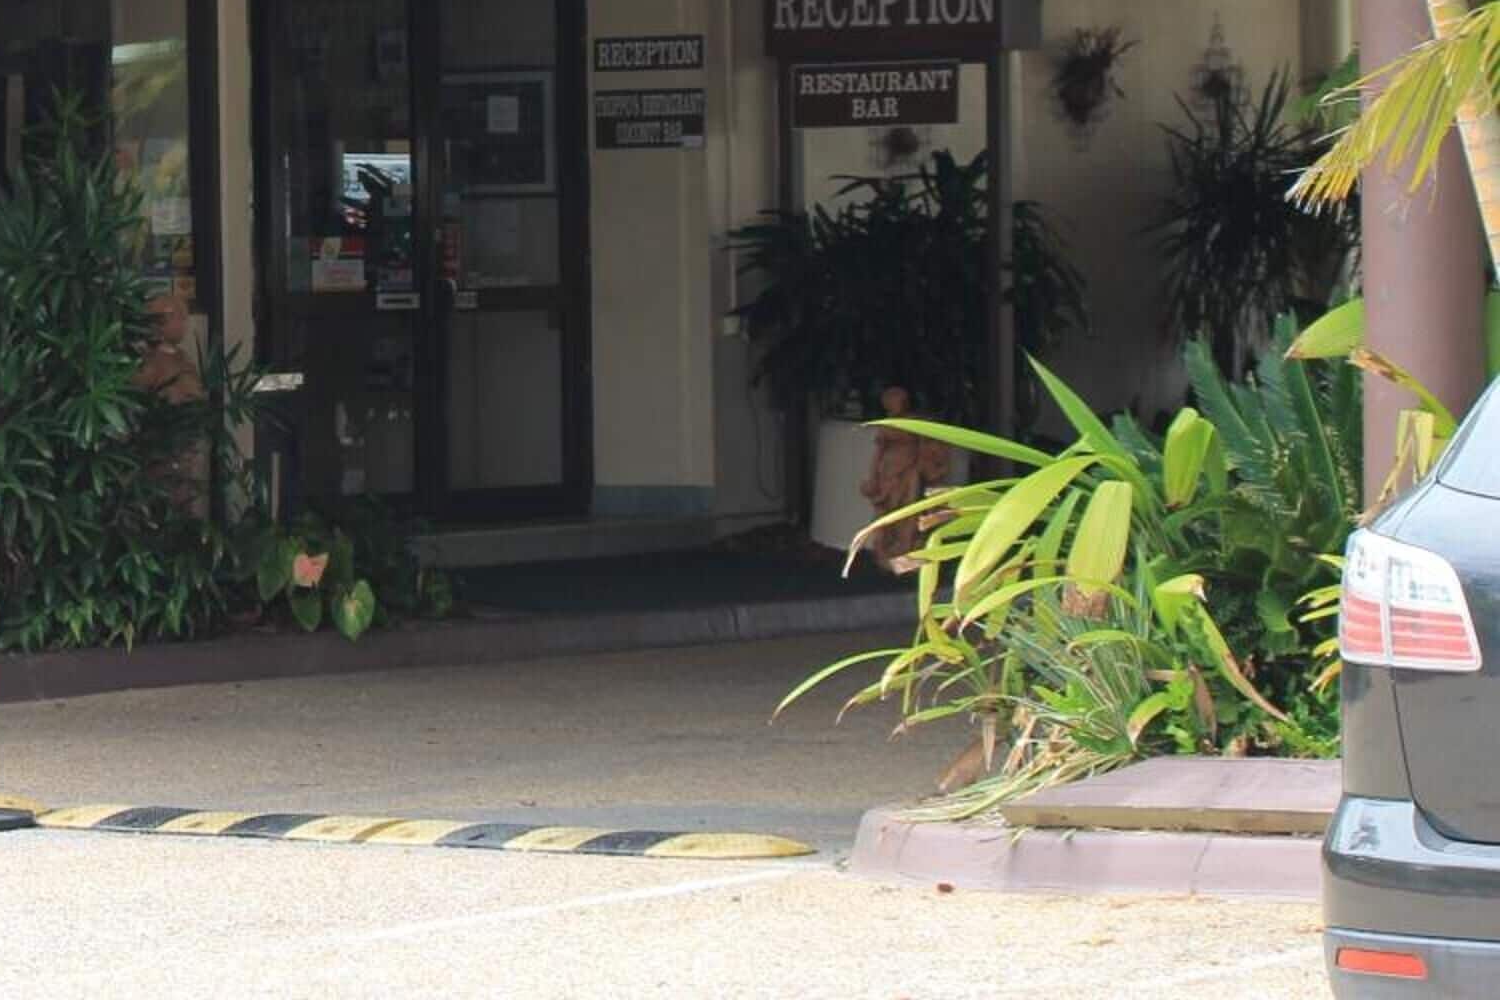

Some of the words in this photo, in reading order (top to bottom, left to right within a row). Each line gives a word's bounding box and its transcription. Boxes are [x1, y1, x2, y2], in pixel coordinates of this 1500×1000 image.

[596, 39, 701, 67] RECEPTION
[799, 69, 954, 96] RESTAURANT
[851, 97, 900, 120] BAR
